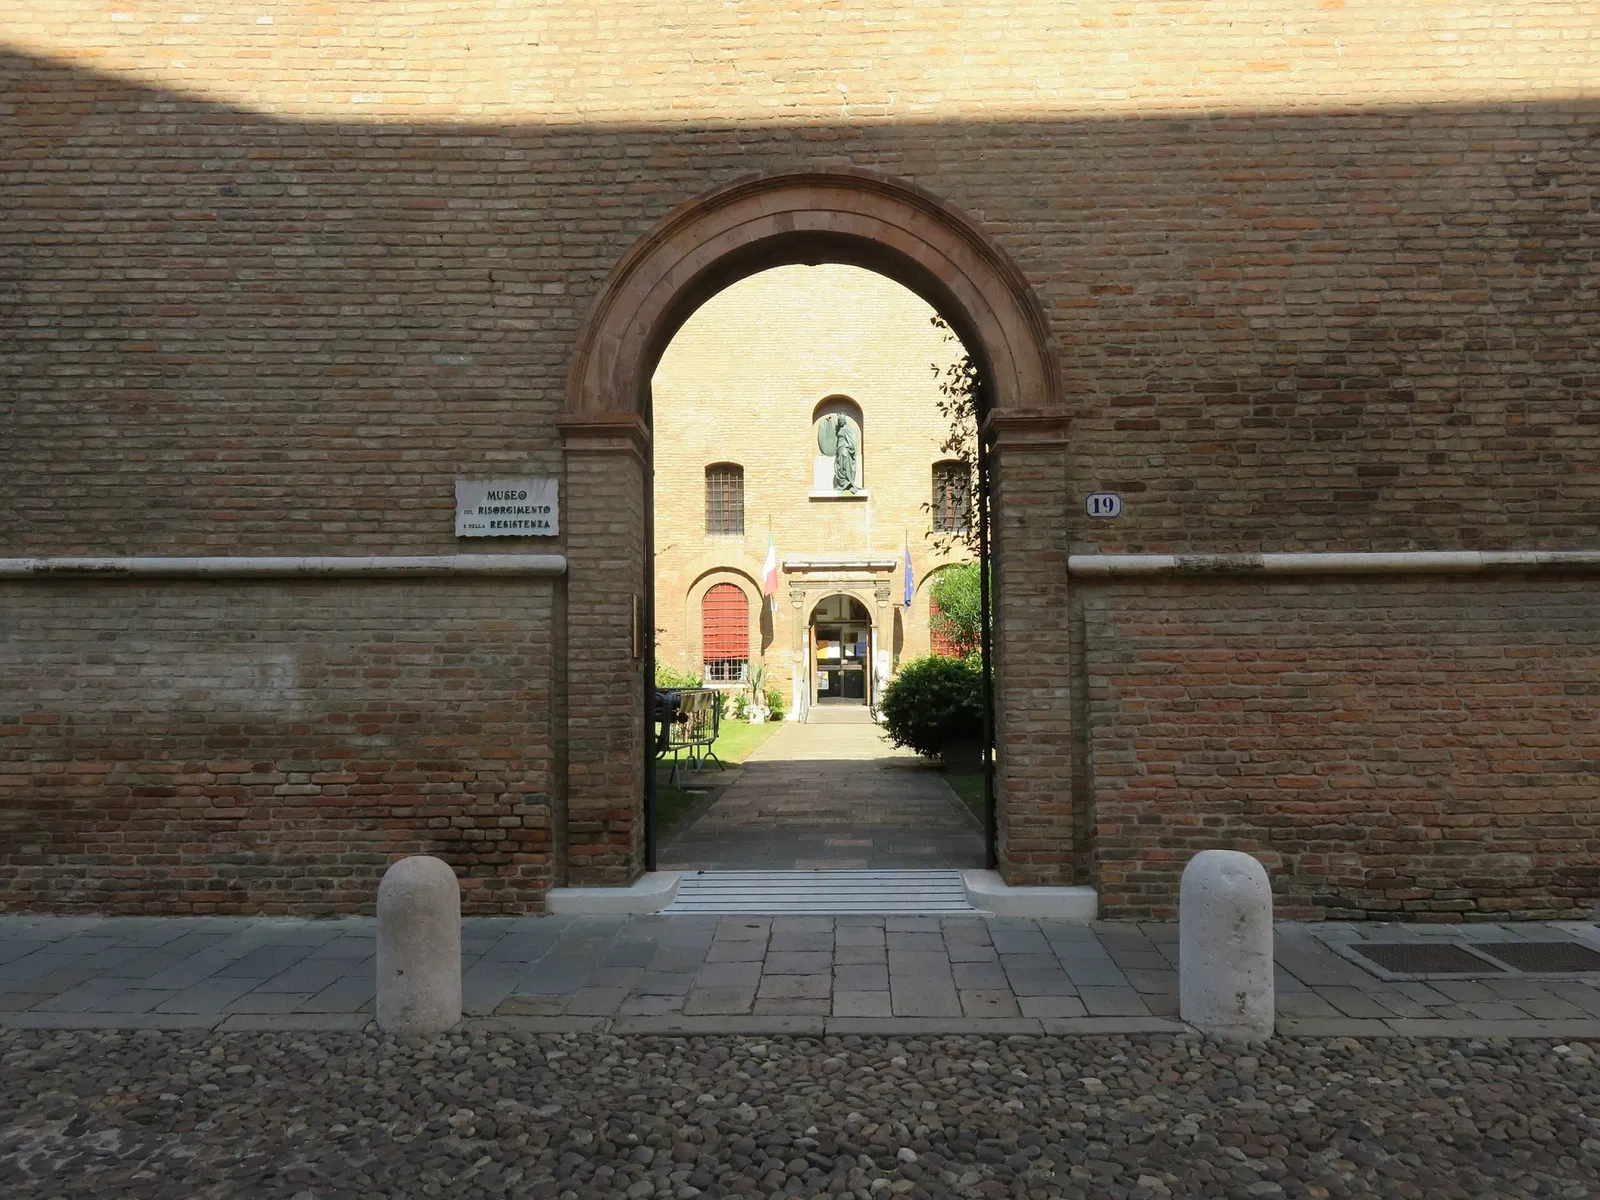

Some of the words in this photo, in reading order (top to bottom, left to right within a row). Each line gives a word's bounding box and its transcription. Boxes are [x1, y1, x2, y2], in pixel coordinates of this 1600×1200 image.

[487, 490, 527, 500] MUSEO
[1092, 497, 1114, 513] 19
[478, 506, 551, 515] RISORGIMENTO
[490, 520, 551, 529] RESISTENZA
